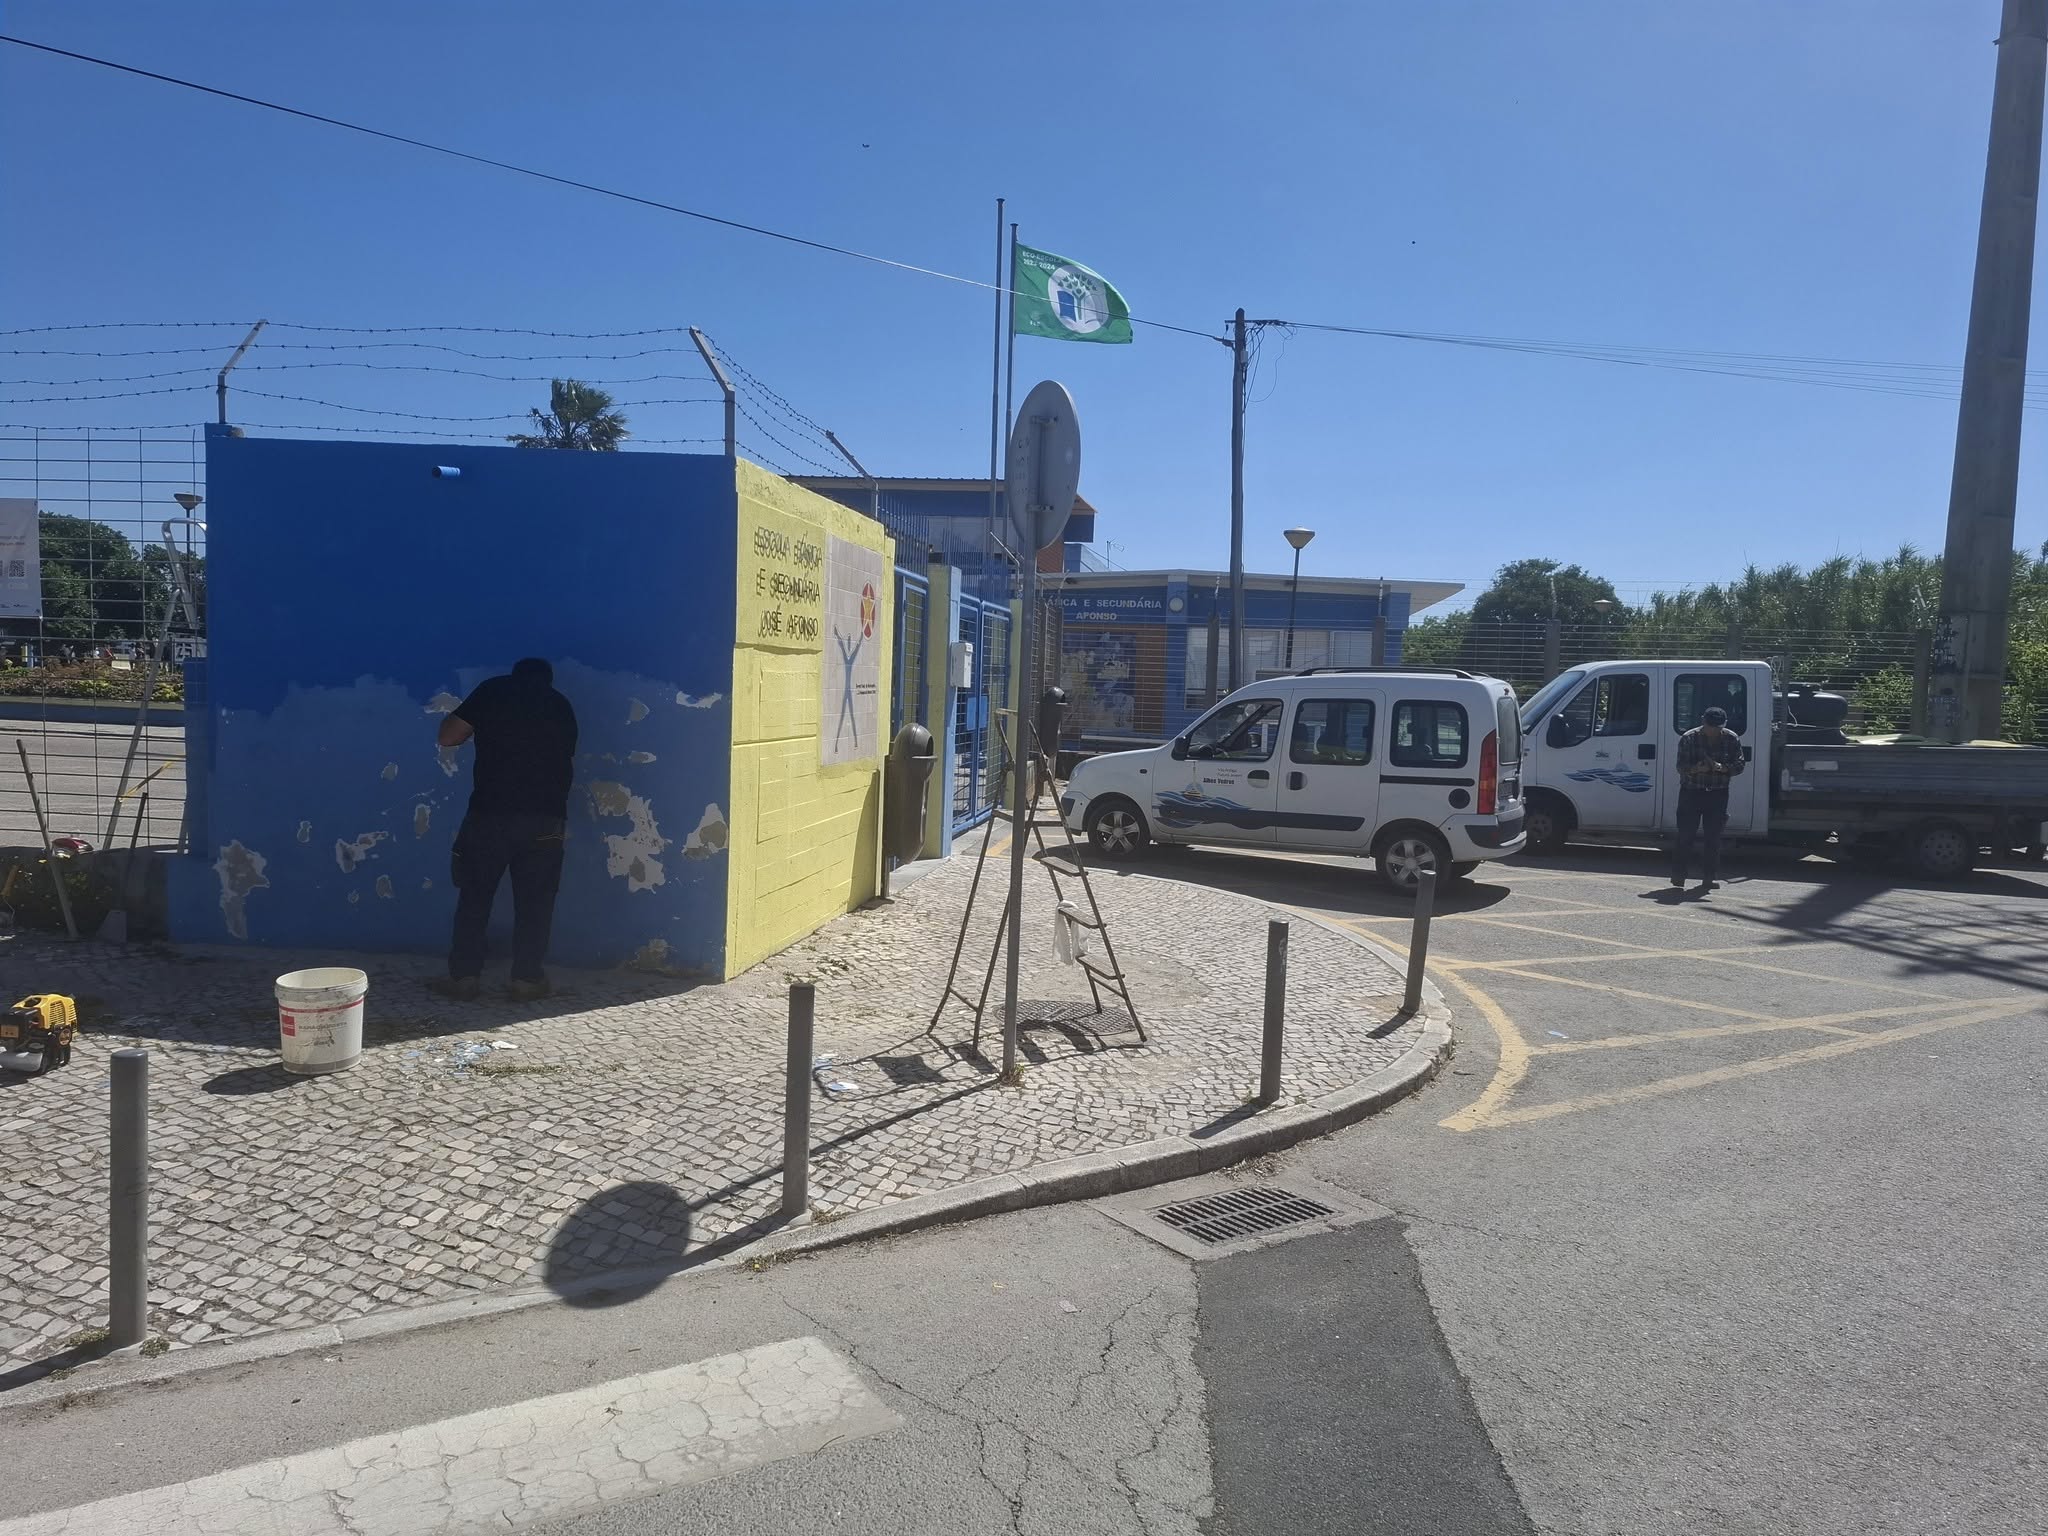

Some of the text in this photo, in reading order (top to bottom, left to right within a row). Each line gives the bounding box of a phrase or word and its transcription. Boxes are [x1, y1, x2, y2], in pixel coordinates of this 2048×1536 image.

[1084, 599, 1091, 607] E
[1096, 597, 1162, 609] SECUNDÁRIA
[1075, 611, 1117, 621] AFONSO
